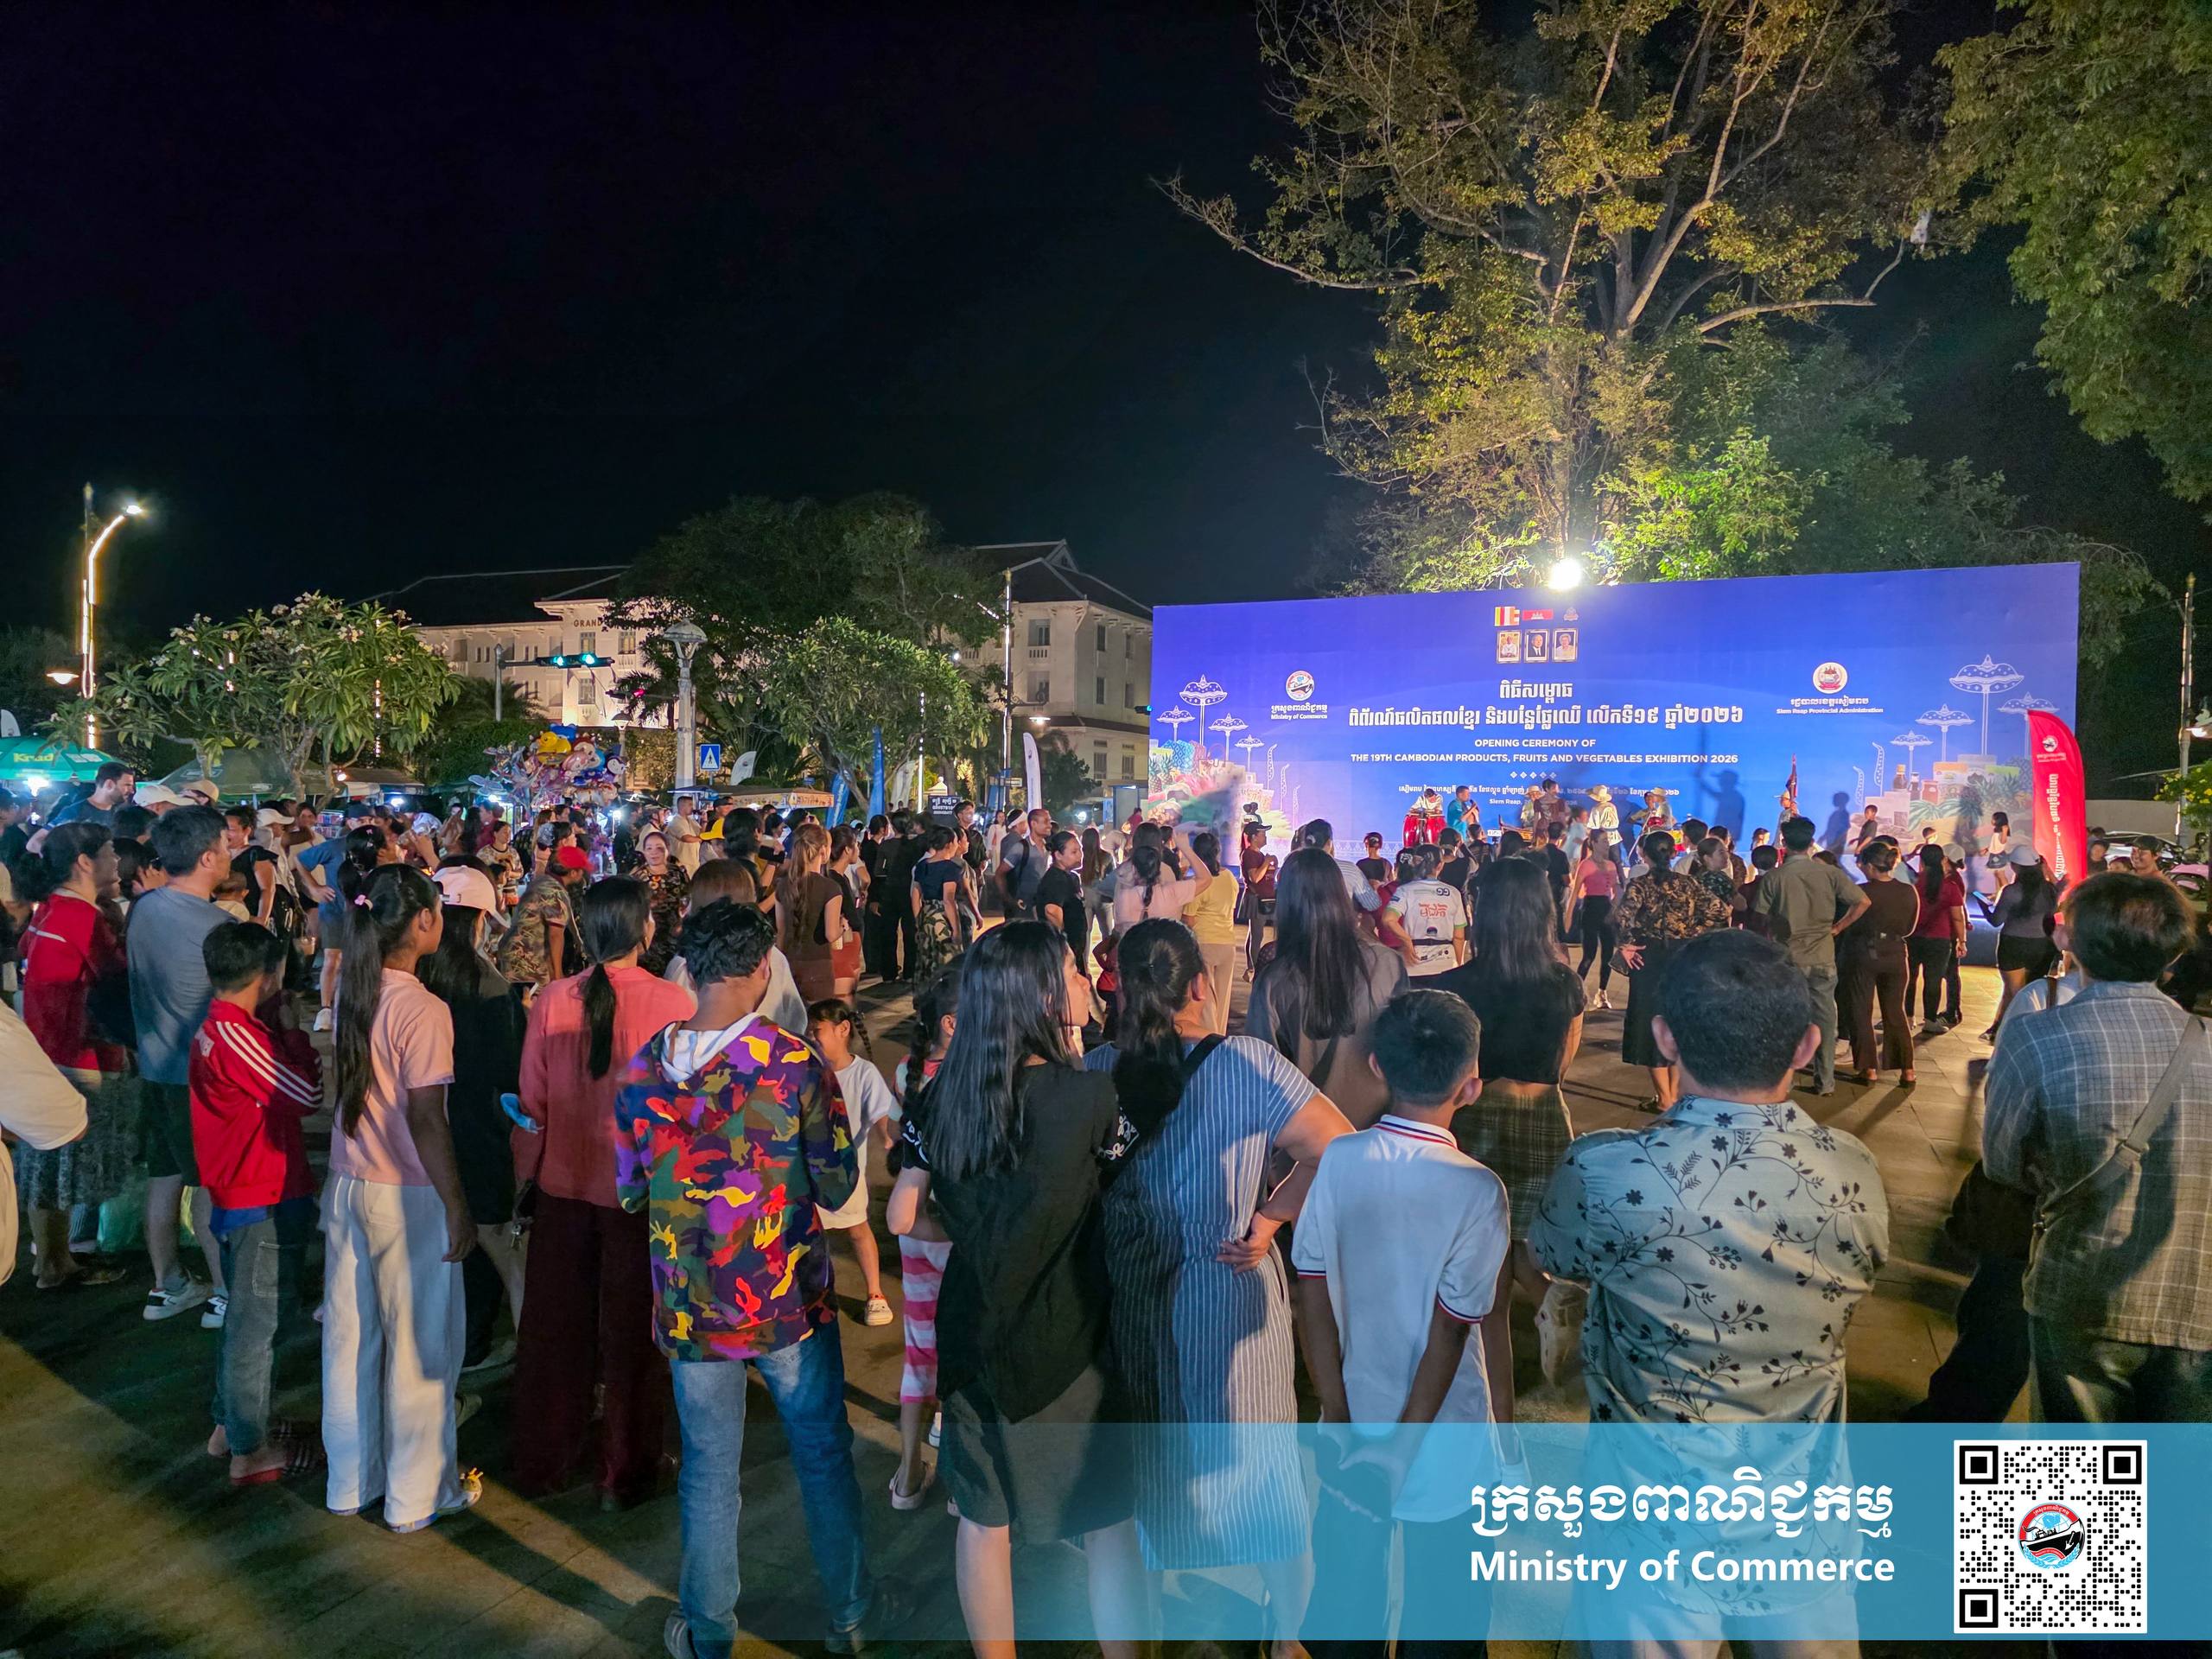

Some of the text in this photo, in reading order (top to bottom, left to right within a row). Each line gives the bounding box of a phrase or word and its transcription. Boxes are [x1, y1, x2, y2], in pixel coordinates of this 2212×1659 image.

[1499, 679, 1573, 703] ពិធីសម្ពោធ
[1474, 739, 1597, 747] OPENING CEREMONY OF
[1350, 753, 1738, 764] THE 19TH CAMBODIAN PRODUCTS, FRUITS AND VEGETABLES EXHIBITION 2026
